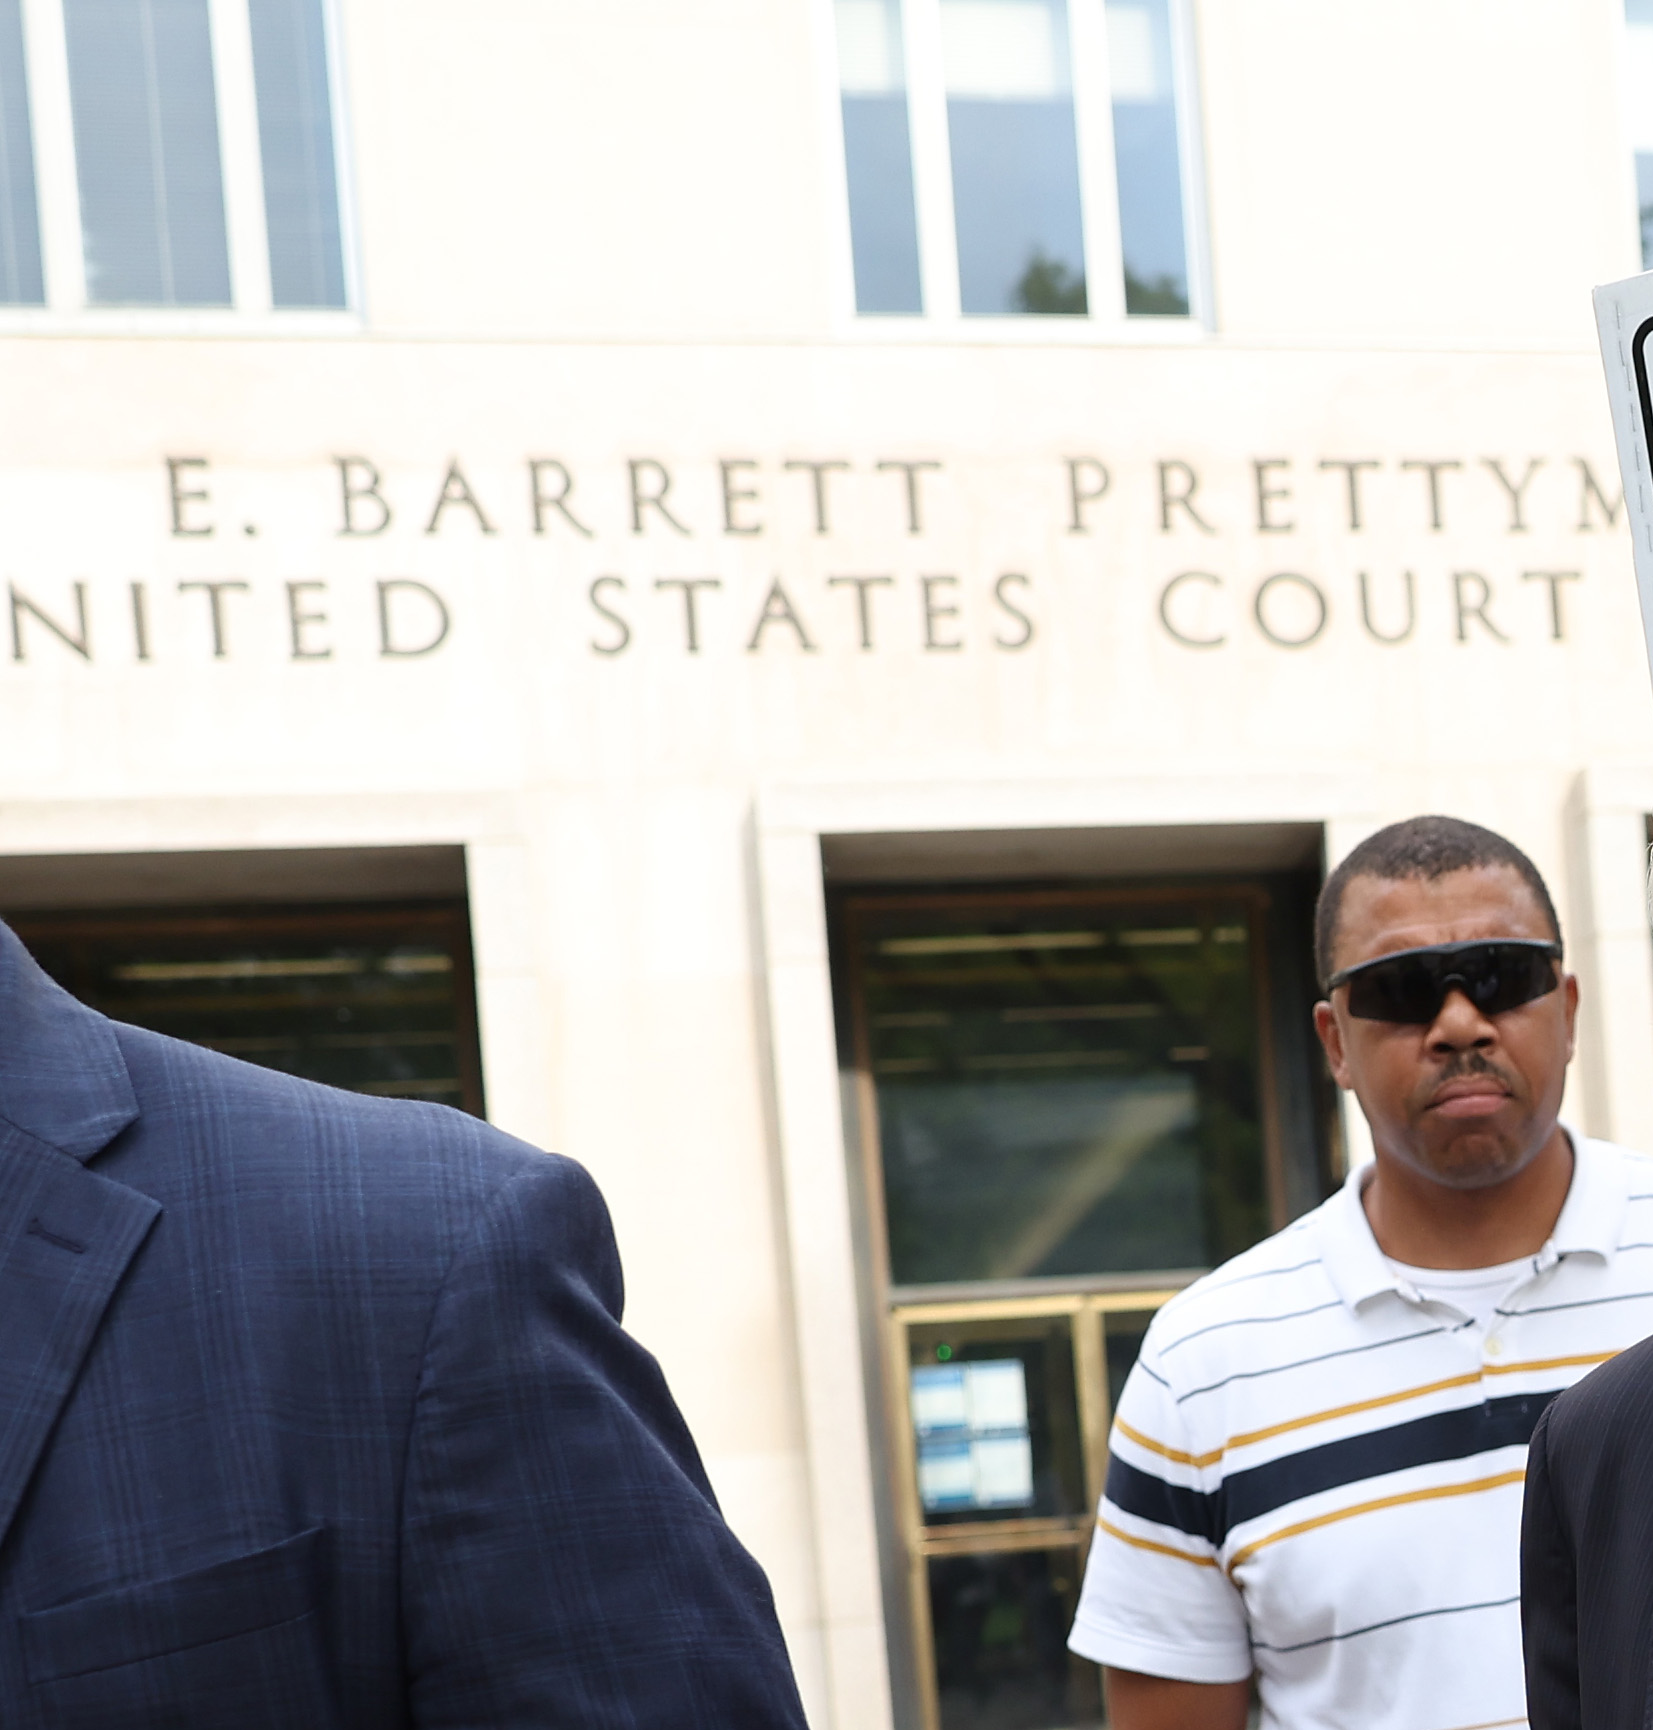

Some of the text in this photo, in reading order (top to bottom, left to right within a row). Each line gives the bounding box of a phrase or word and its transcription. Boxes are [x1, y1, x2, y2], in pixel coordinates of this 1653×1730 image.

[165, 455, 258, 538] E.
[332, 455, 942, 538] BARRETT
[8, 570, 1583, 661] NITED STATES COURT
